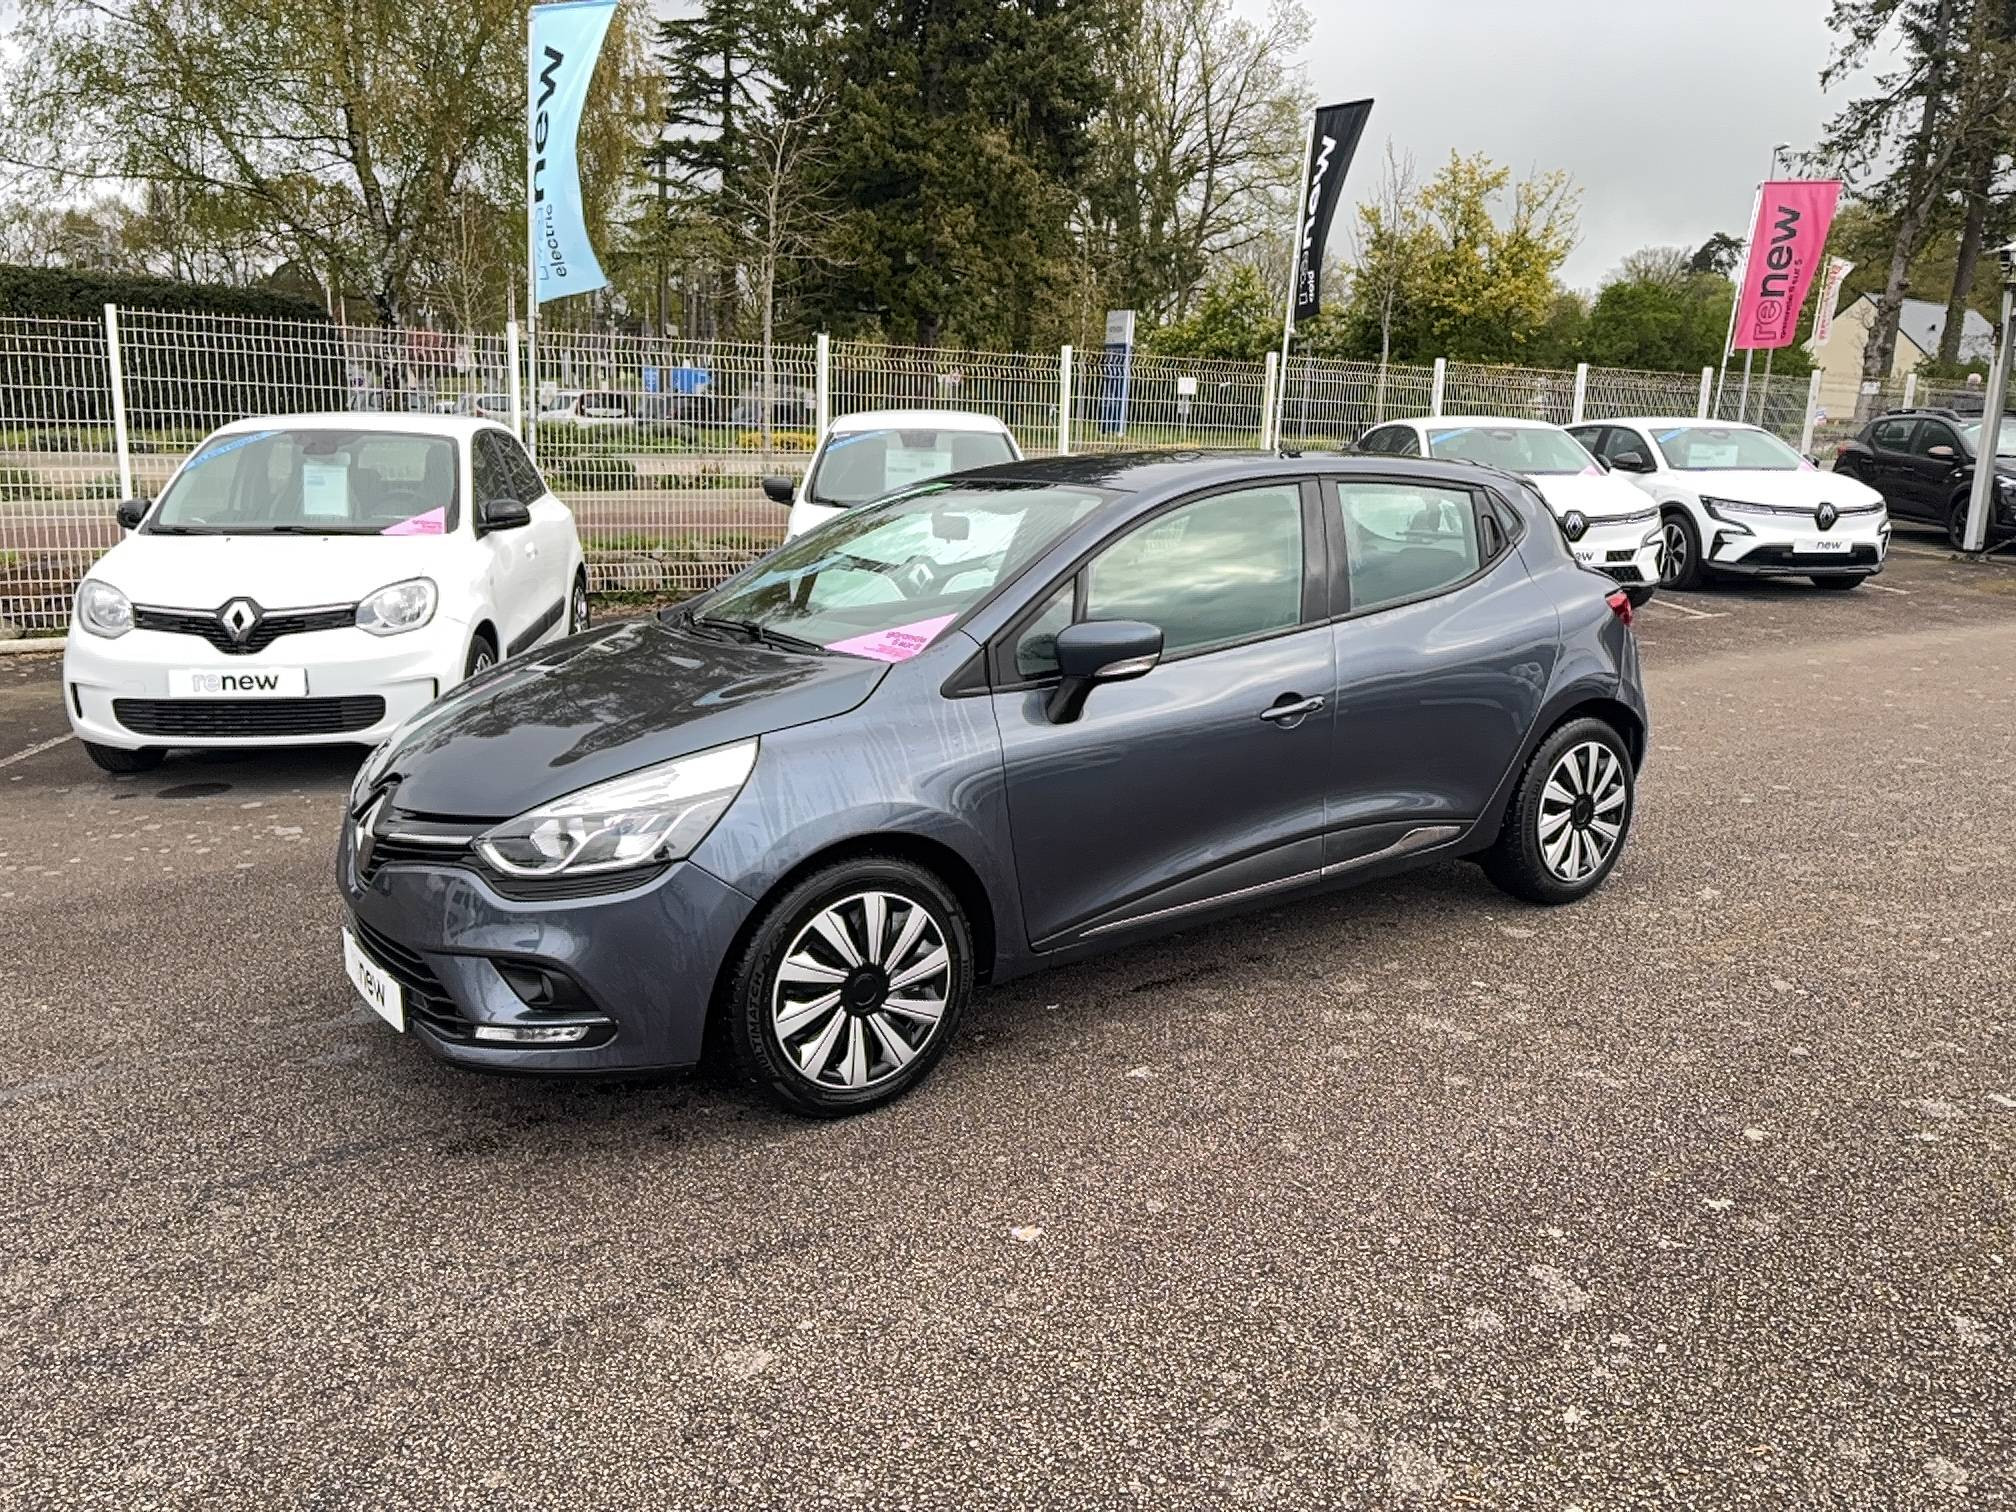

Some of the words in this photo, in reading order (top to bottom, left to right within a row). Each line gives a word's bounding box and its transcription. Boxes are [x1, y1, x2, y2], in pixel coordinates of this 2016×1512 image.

[546, 203, 568, 279] electric
[1753, 206, 1801, 341] renew
[1574, 551, 1594, 561] ew
[192, 674, 279, 693] renew
